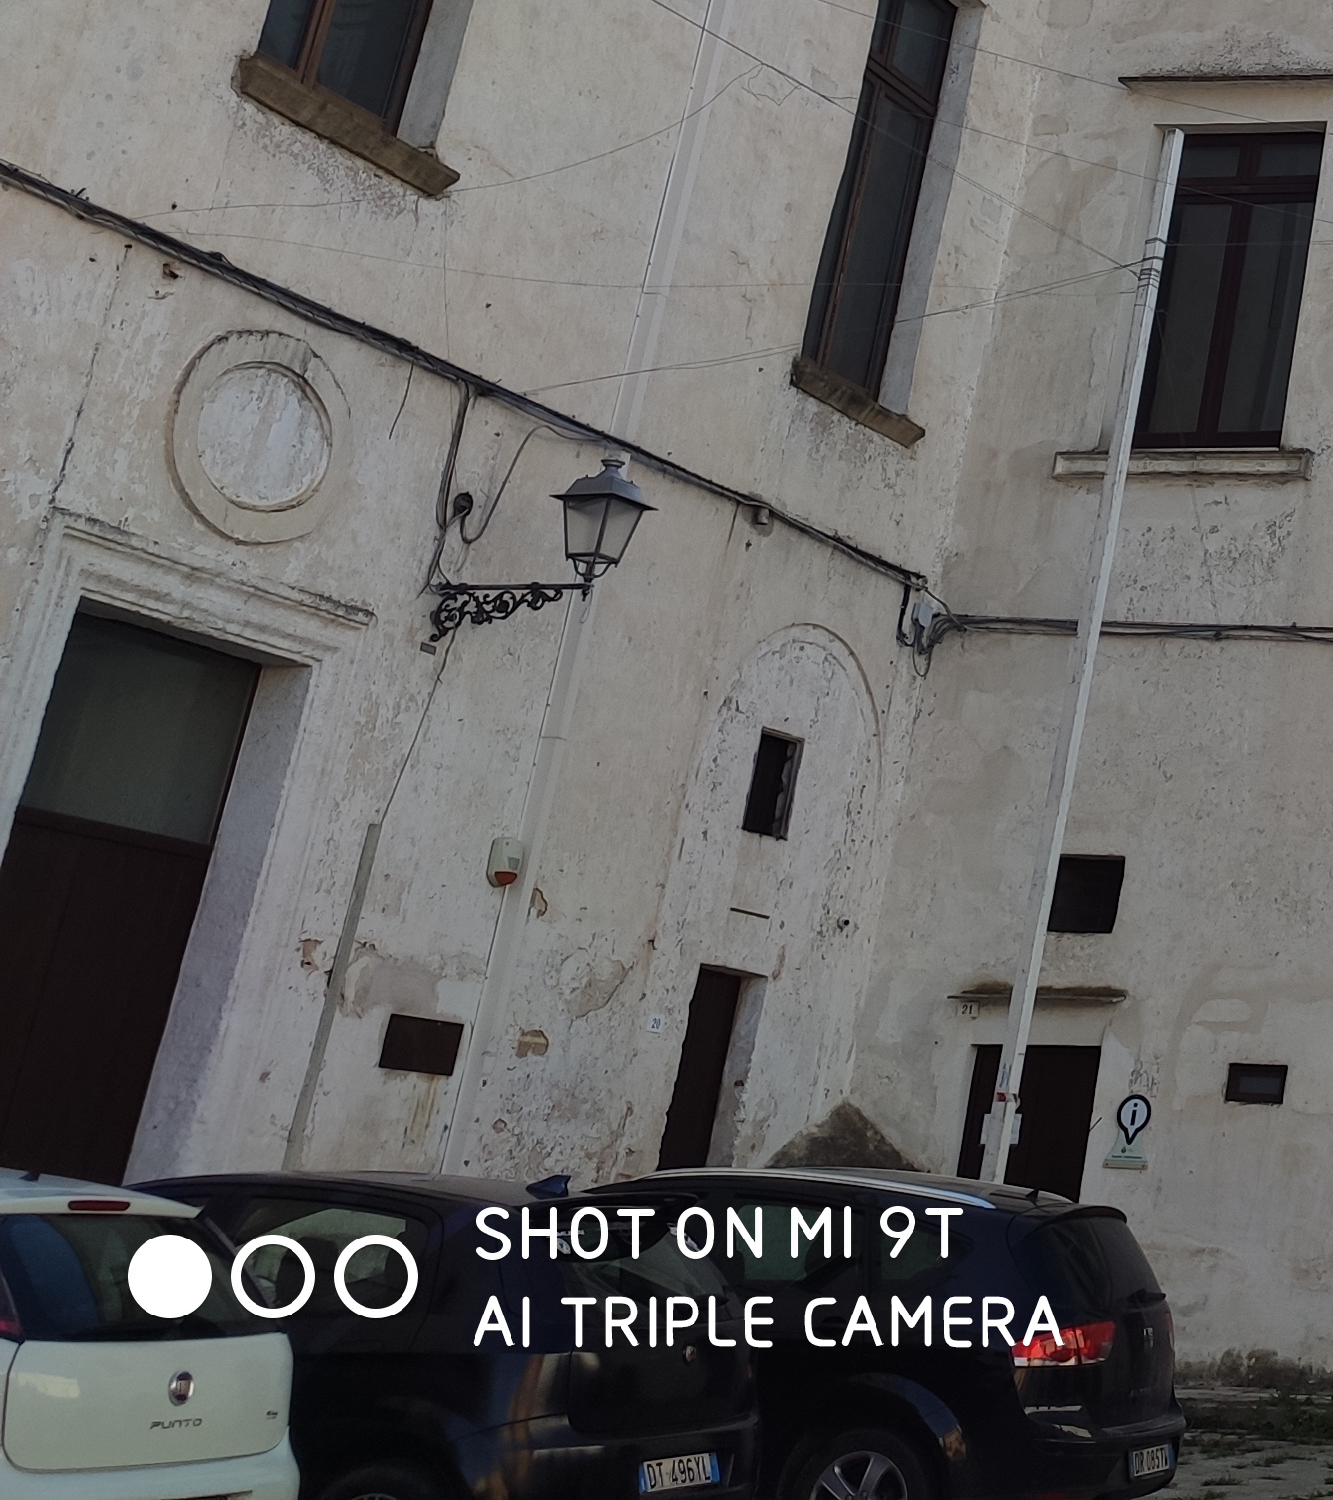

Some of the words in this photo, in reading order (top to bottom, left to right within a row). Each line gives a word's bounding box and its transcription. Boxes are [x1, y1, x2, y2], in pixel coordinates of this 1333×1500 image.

[962, 1004, 973, 1015] 21
[651, 1017, 661, 1030] 20
[150, 1418, 203, 1430] PUNTO
[646, 1461, 664, 1489] DT
[671, 1455, 711, 1485] 496YL
